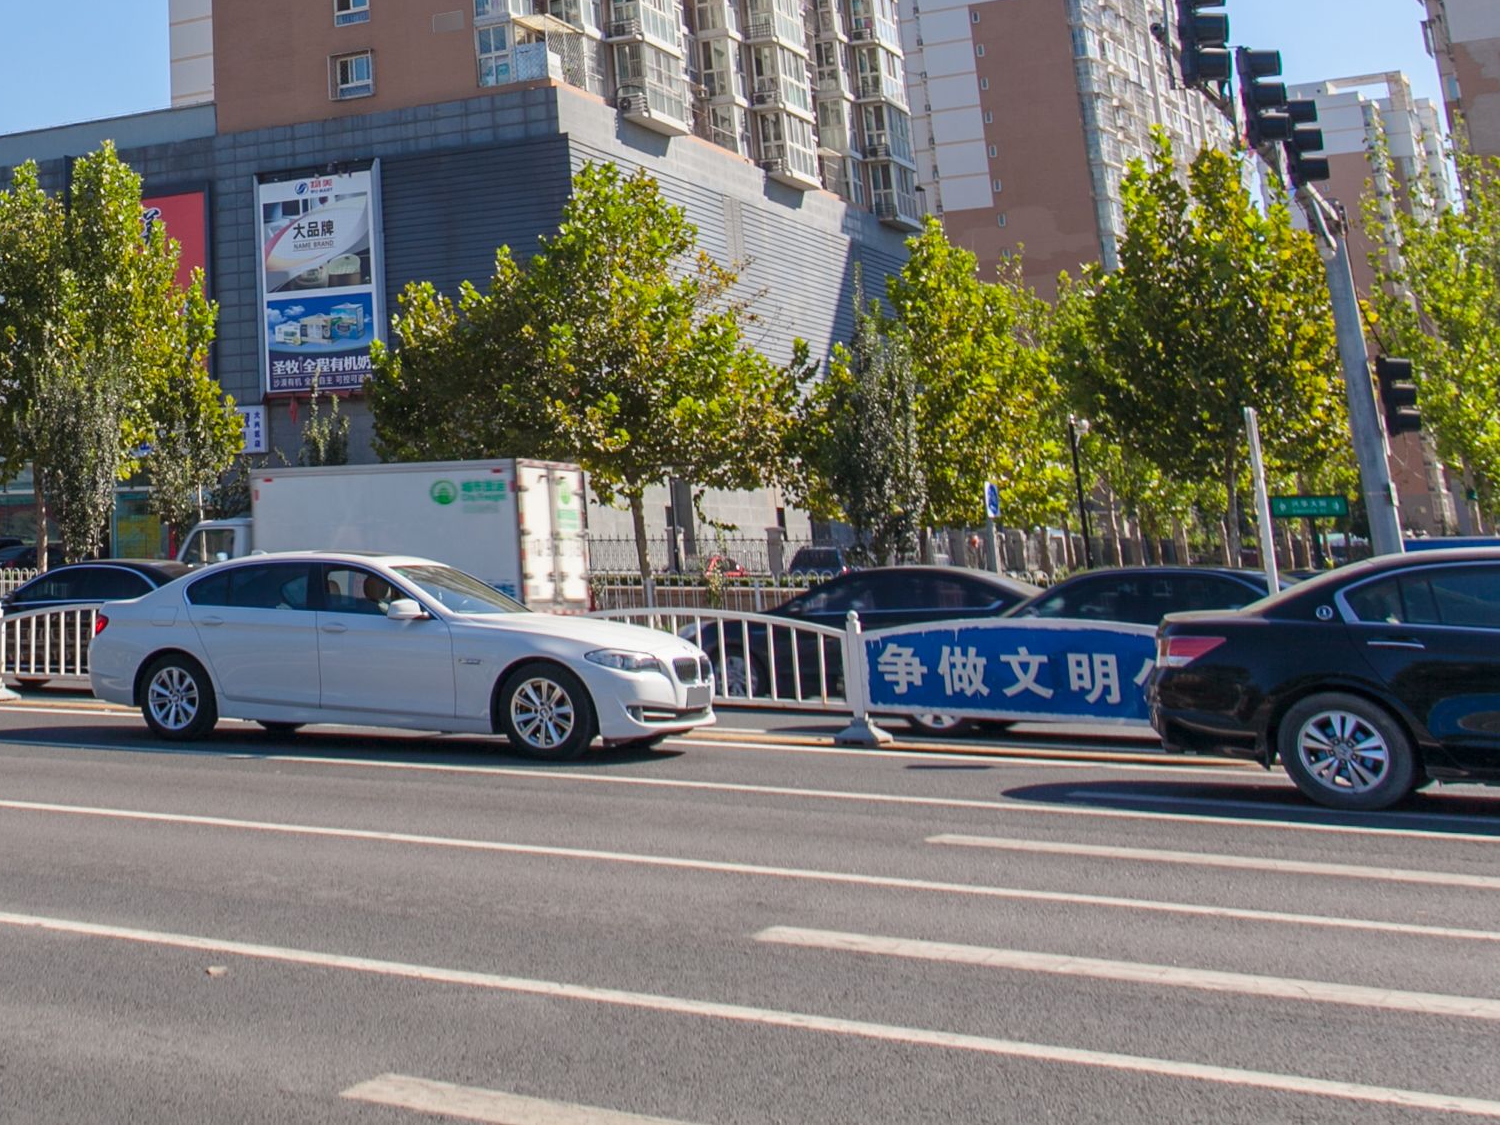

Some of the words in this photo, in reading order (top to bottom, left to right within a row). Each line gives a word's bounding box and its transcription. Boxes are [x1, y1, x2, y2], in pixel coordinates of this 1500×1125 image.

[293, 220, 334, 240] 大品牌
[293, 240, 311, 249] NAME
[313, 239, 334, 248] BRAND
[272, 360, 299, 375] 圣牧
[302, 355, 371, 373] 全程有机奶
